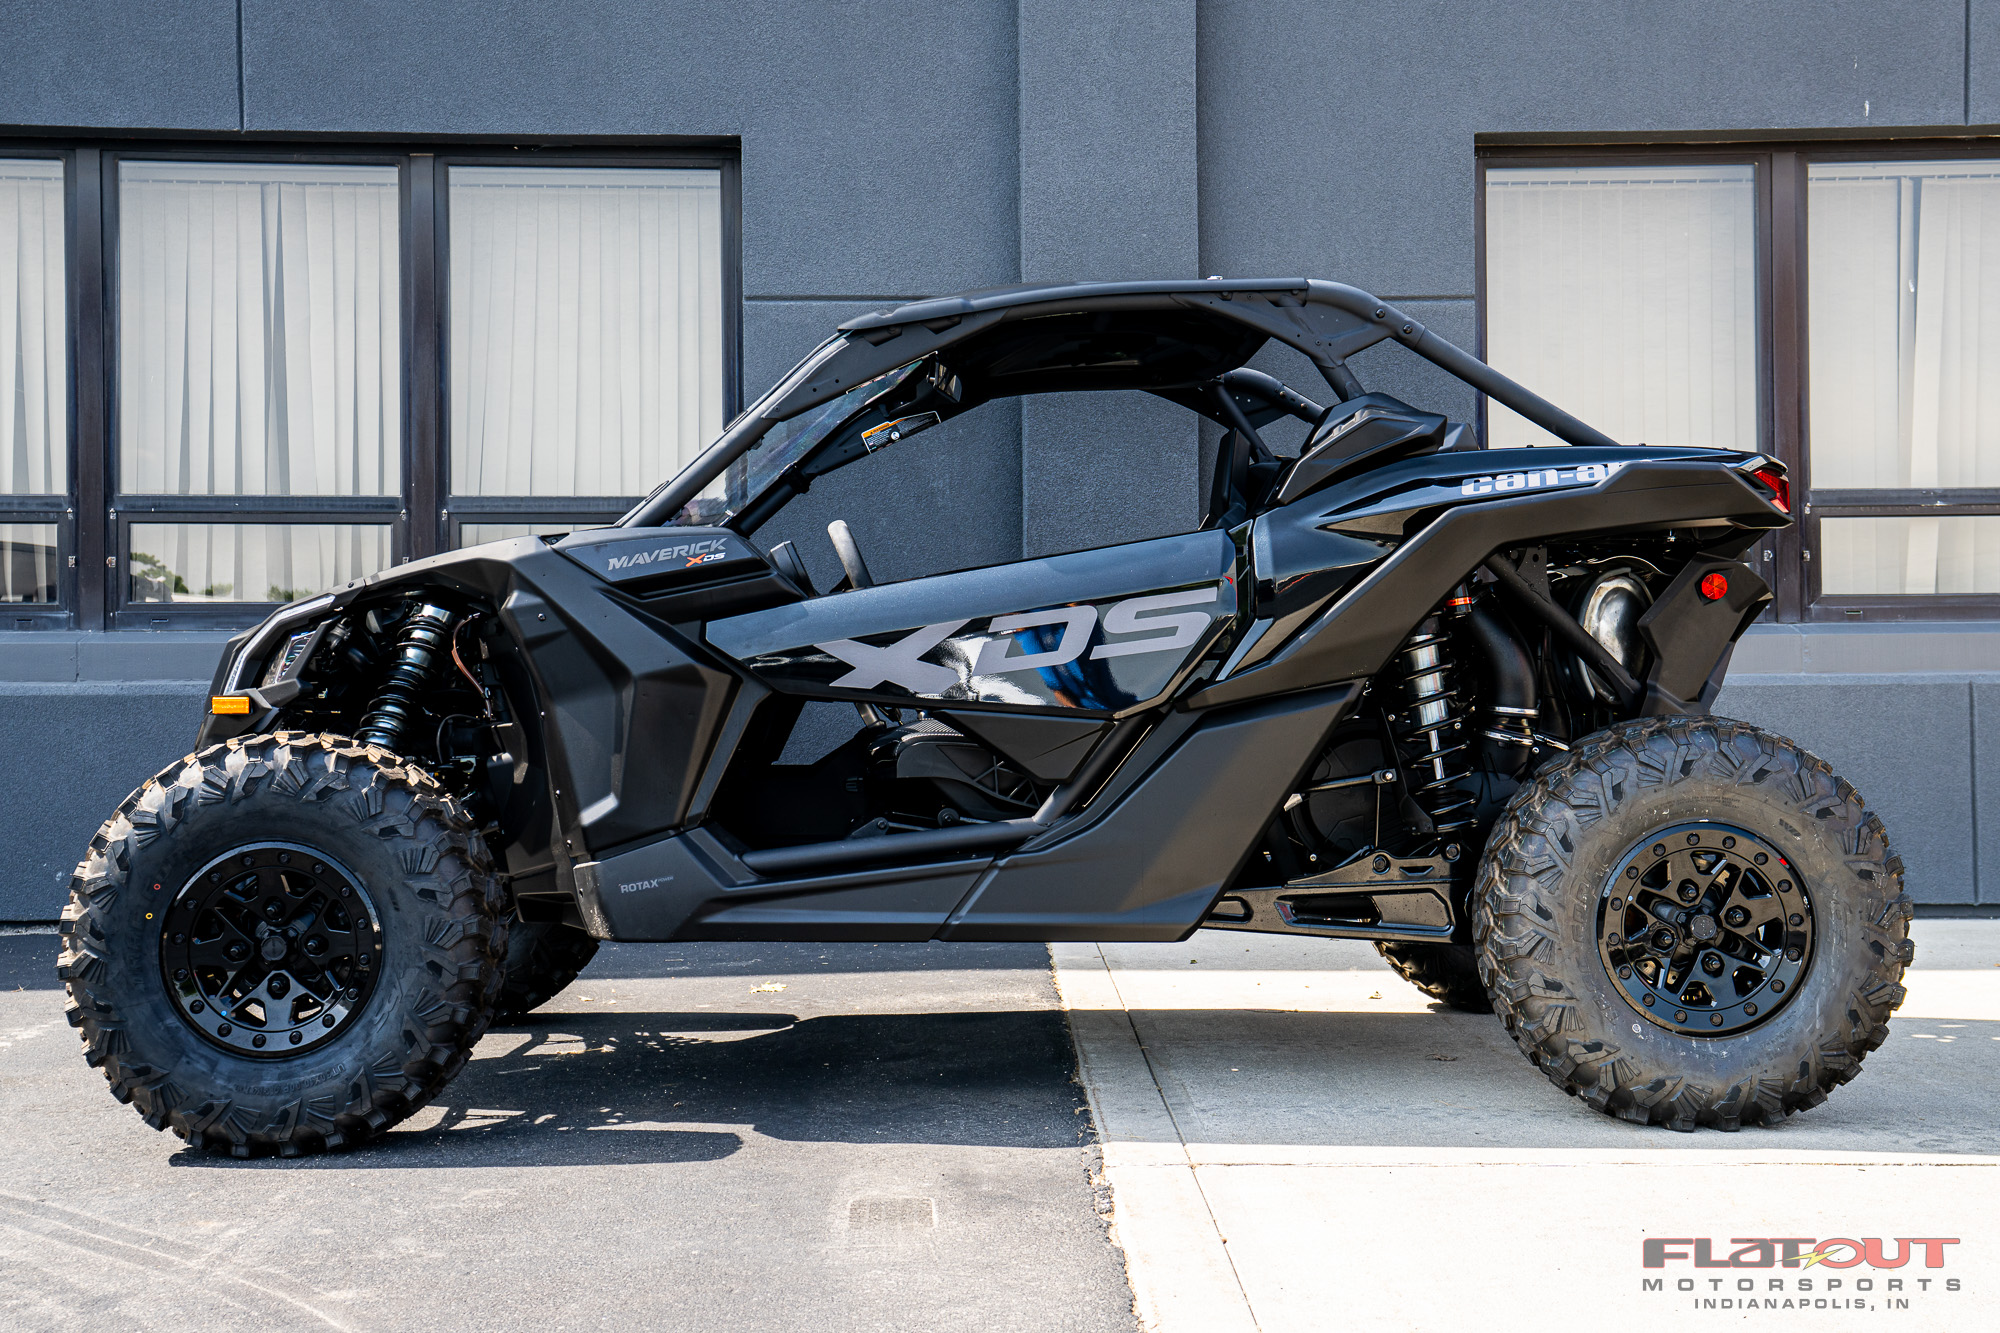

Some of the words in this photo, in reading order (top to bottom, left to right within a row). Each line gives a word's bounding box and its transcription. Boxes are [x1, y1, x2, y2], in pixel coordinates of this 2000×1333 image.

[608, 538, 726, 571] MAVERICK
[814, 587, 1217, 695] XDS
[620, 879, 659, 894] ROTAX
